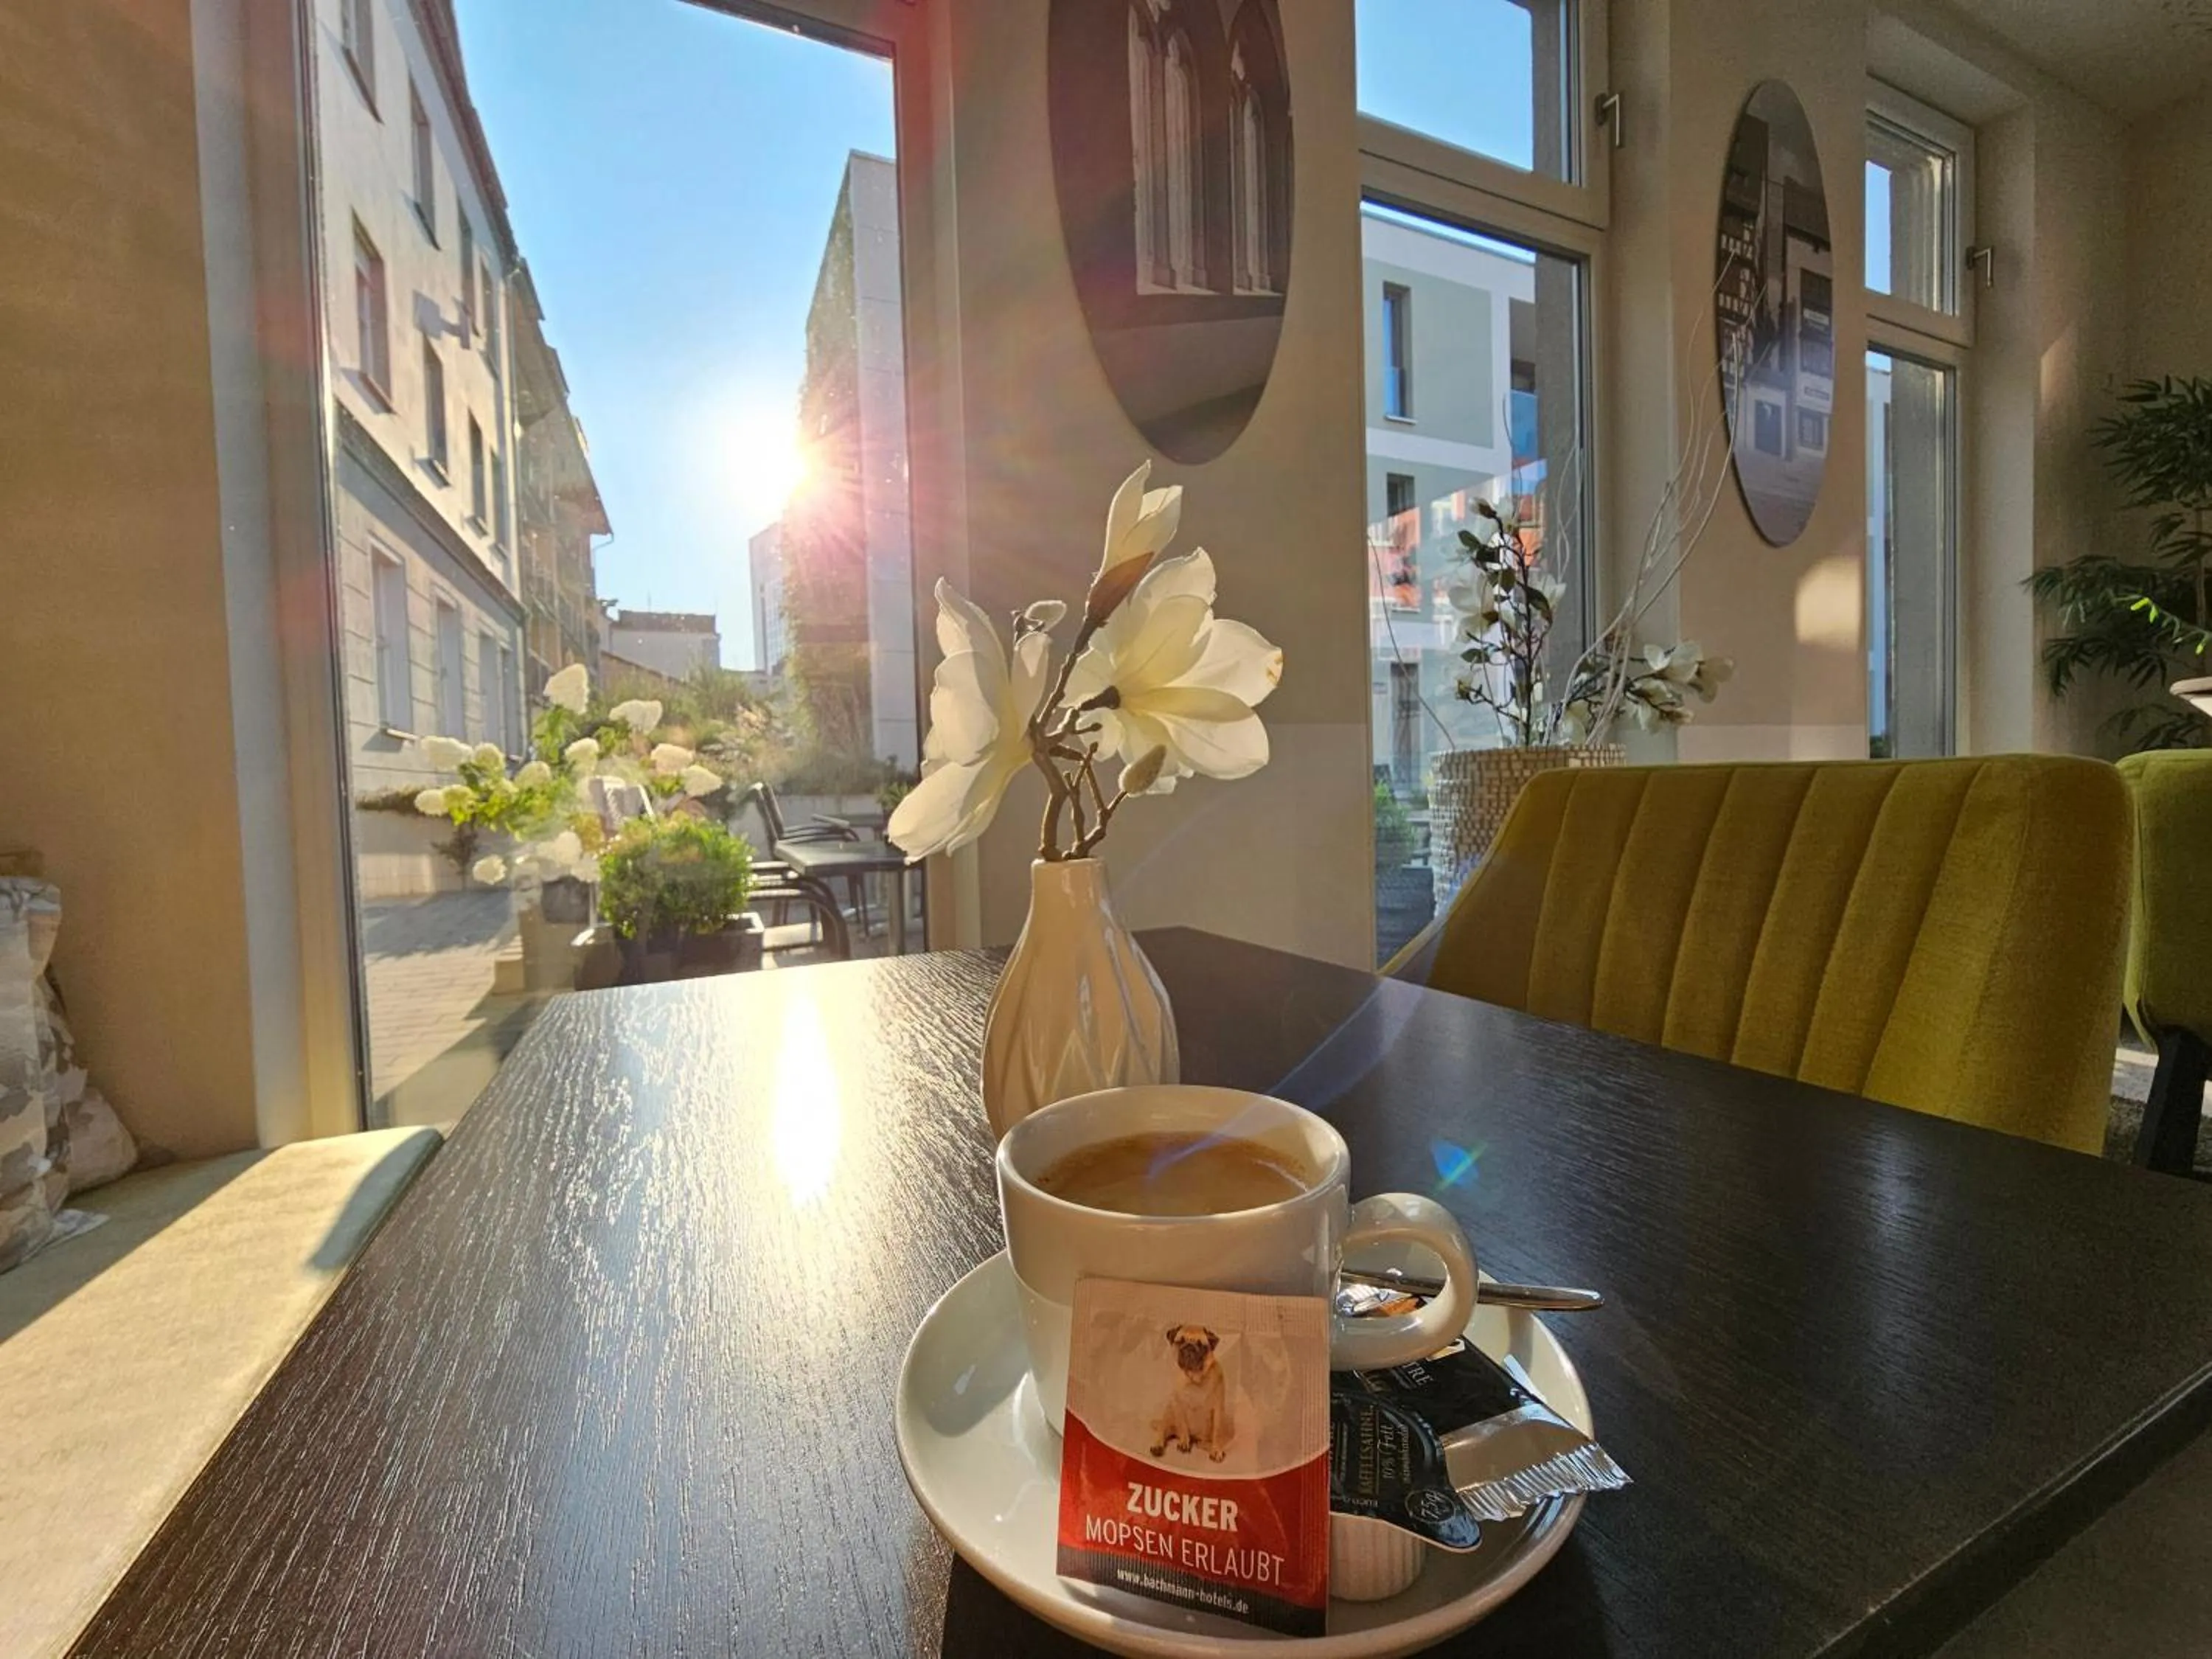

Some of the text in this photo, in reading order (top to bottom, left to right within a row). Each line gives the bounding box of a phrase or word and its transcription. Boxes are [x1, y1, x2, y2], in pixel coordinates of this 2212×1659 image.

[1127, 1481, 1239, 1532] ZUCKER
[1086, 1514, 1285, 1585] MOPSEN ERLAUBT
[1117, 1568, 1250, 1615] www.bachmann-hotels.de
